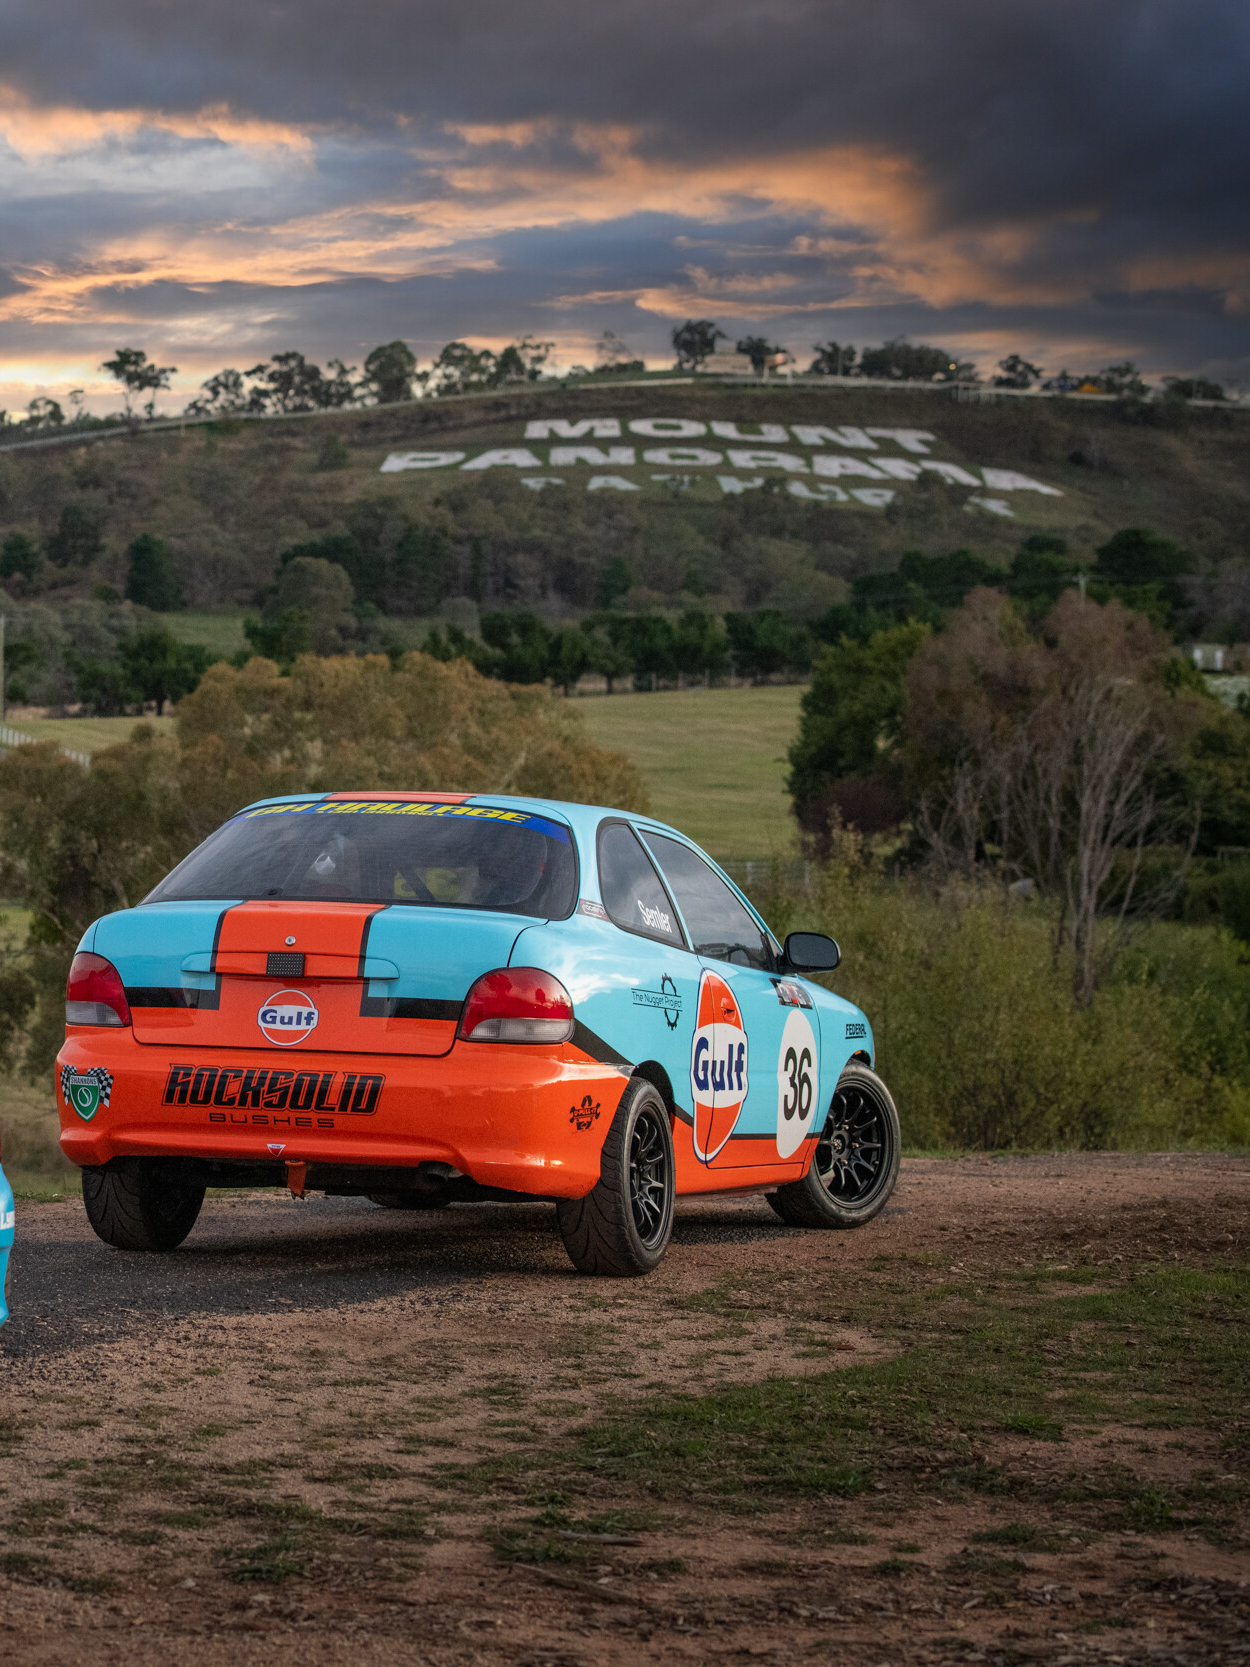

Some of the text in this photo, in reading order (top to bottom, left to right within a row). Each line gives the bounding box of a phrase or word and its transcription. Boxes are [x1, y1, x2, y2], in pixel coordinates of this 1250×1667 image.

[524, 418, 937, 454] MOUNT
[380, 446, 1065, 497] PANORAMA
[317, 802, 533, 824] HAULAGE
[632, 991, 643, 1002] The
[261, 1008, 316, 1027] Gulf
[845, 1023, 867, 1036] FEDERAL
[693, 1036, 745, 1092] Gulf
[71, 1076, 96, 1085] SHANNONS
[161, 1063, 386, 1116] ROCKSOLID
[783, 1046, 813, 1121] 36
[208, 1112, 335, 1129] BUSHES
